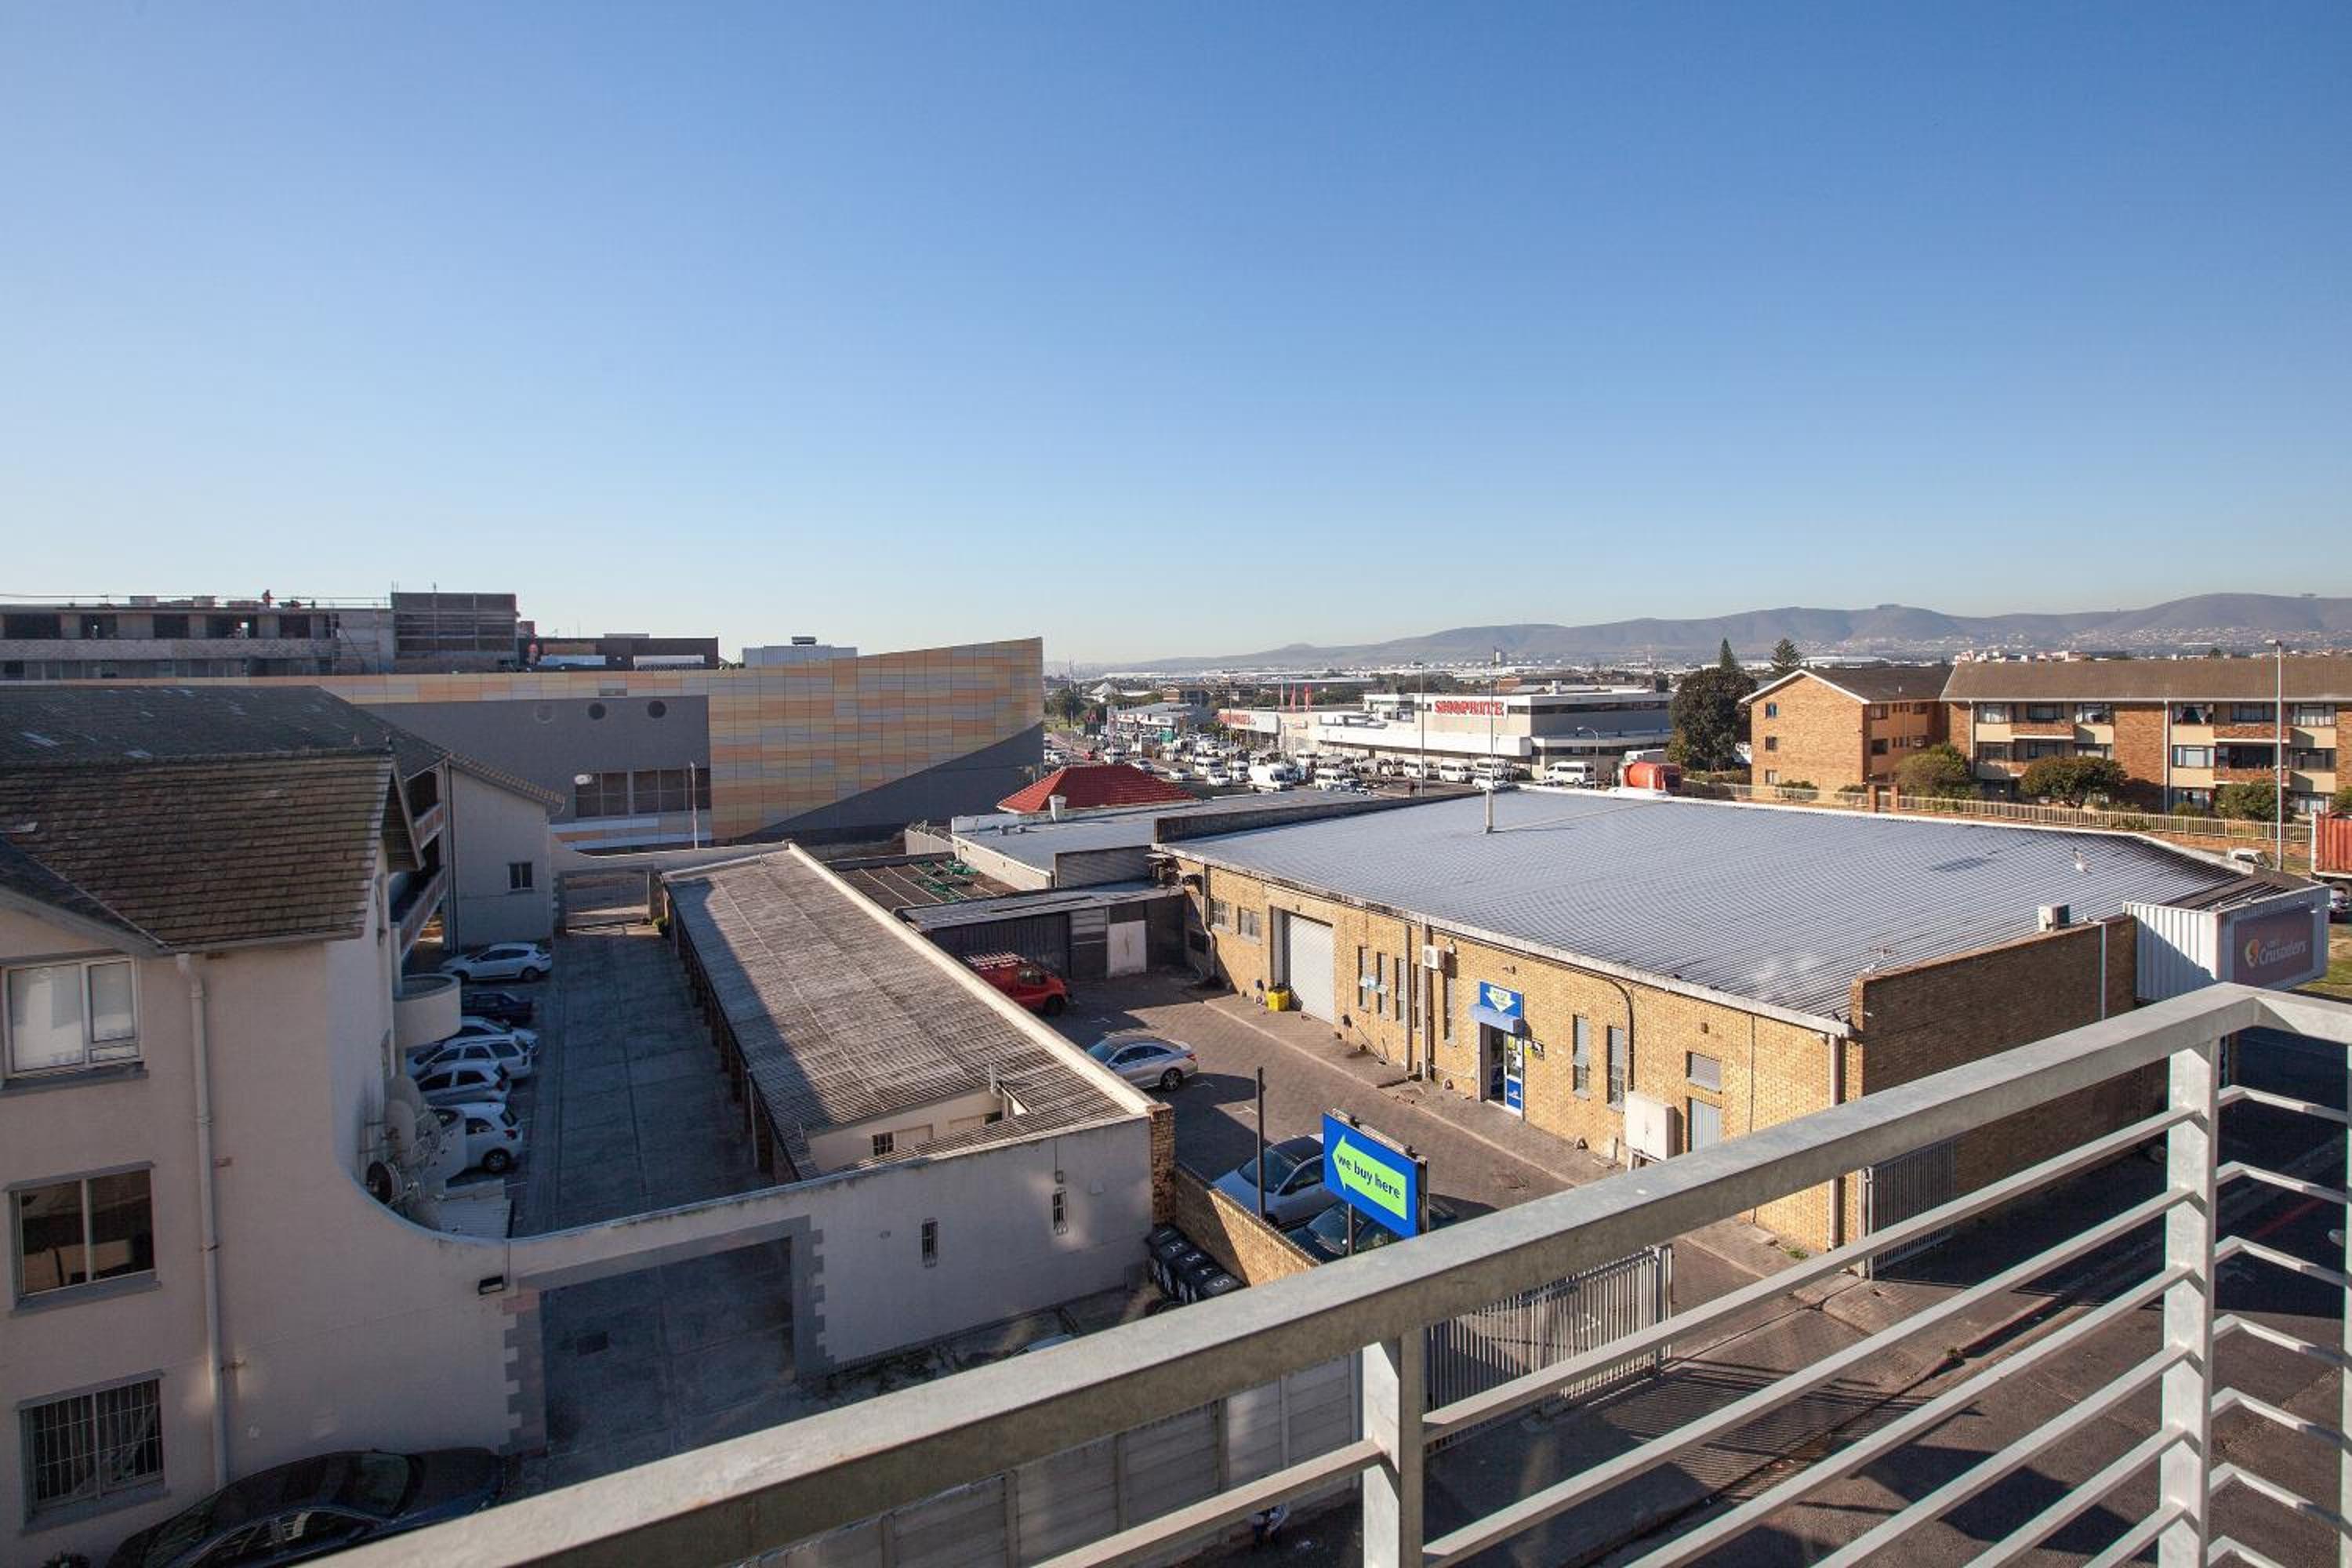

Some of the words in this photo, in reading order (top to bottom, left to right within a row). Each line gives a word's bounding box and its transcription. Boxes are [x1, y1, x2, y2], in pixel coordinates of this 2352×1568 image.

[1435, 700, 1504, 716] SHOPRITE
[1337, 1153, 1351, 1171] we
[1354, 1160, 1373, 1185] buy
[1374, 1172, 1401, 1199] here
